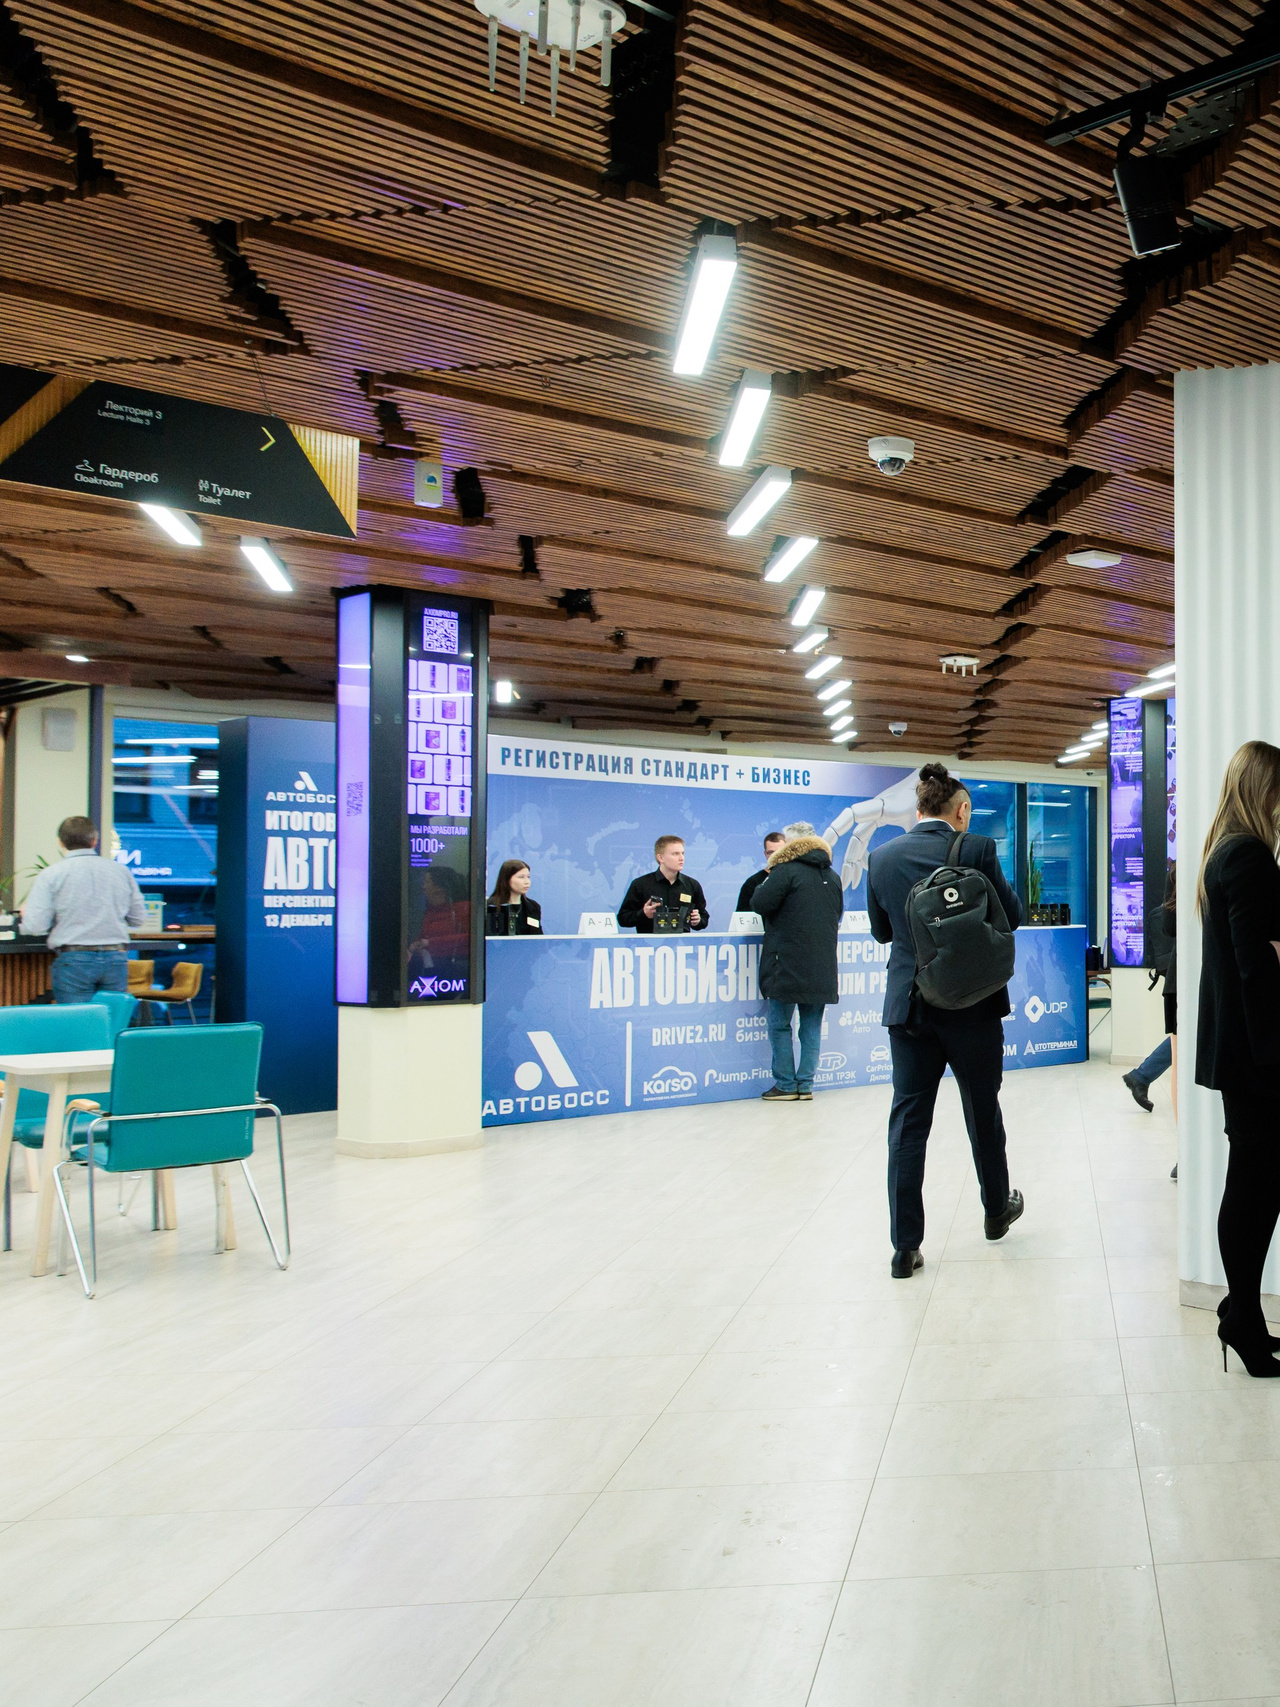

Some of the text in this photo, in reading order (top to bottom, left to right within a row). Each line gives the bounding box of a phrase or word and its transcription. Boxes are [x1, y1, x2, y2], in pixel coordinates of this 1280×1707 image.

[98, 409, 124, 421] Lecture
[144, 418, 150, 426] 3
[105, 400, 162, 420] Лекторий 3
[74, 473, 124, 488] Cloakroom
[100, 464, 159, 484] Гардероб
[211, 482, 252, 500] Туалет
[198, 494, 222, 506] Toilet
[501, 747, 811, 786] РЕГИСТРАЦИЯ СТАНДАРТ + БИЗНЕС
[410, 825, 468, 835] МЫ РАЗРАБОТАЛИ
[410, 838, 446, 853] 1000+
[264, 914, 333, 928] 13 ДЕКАБРЯ
[590, 944, 763, 1009] АВТОБИЗН
[410, 976, 466, 998] AXIOM
[1044, 1002, 1068, 1013] UDP
[652, 1024, 726, 1046] DRIVE2.RU
[836, 1070, 856, 1080] ТРЭК
[870, 1074, 890, 1082] Дилер
[482, 1090, 610, 1117] АВТОБОСС
